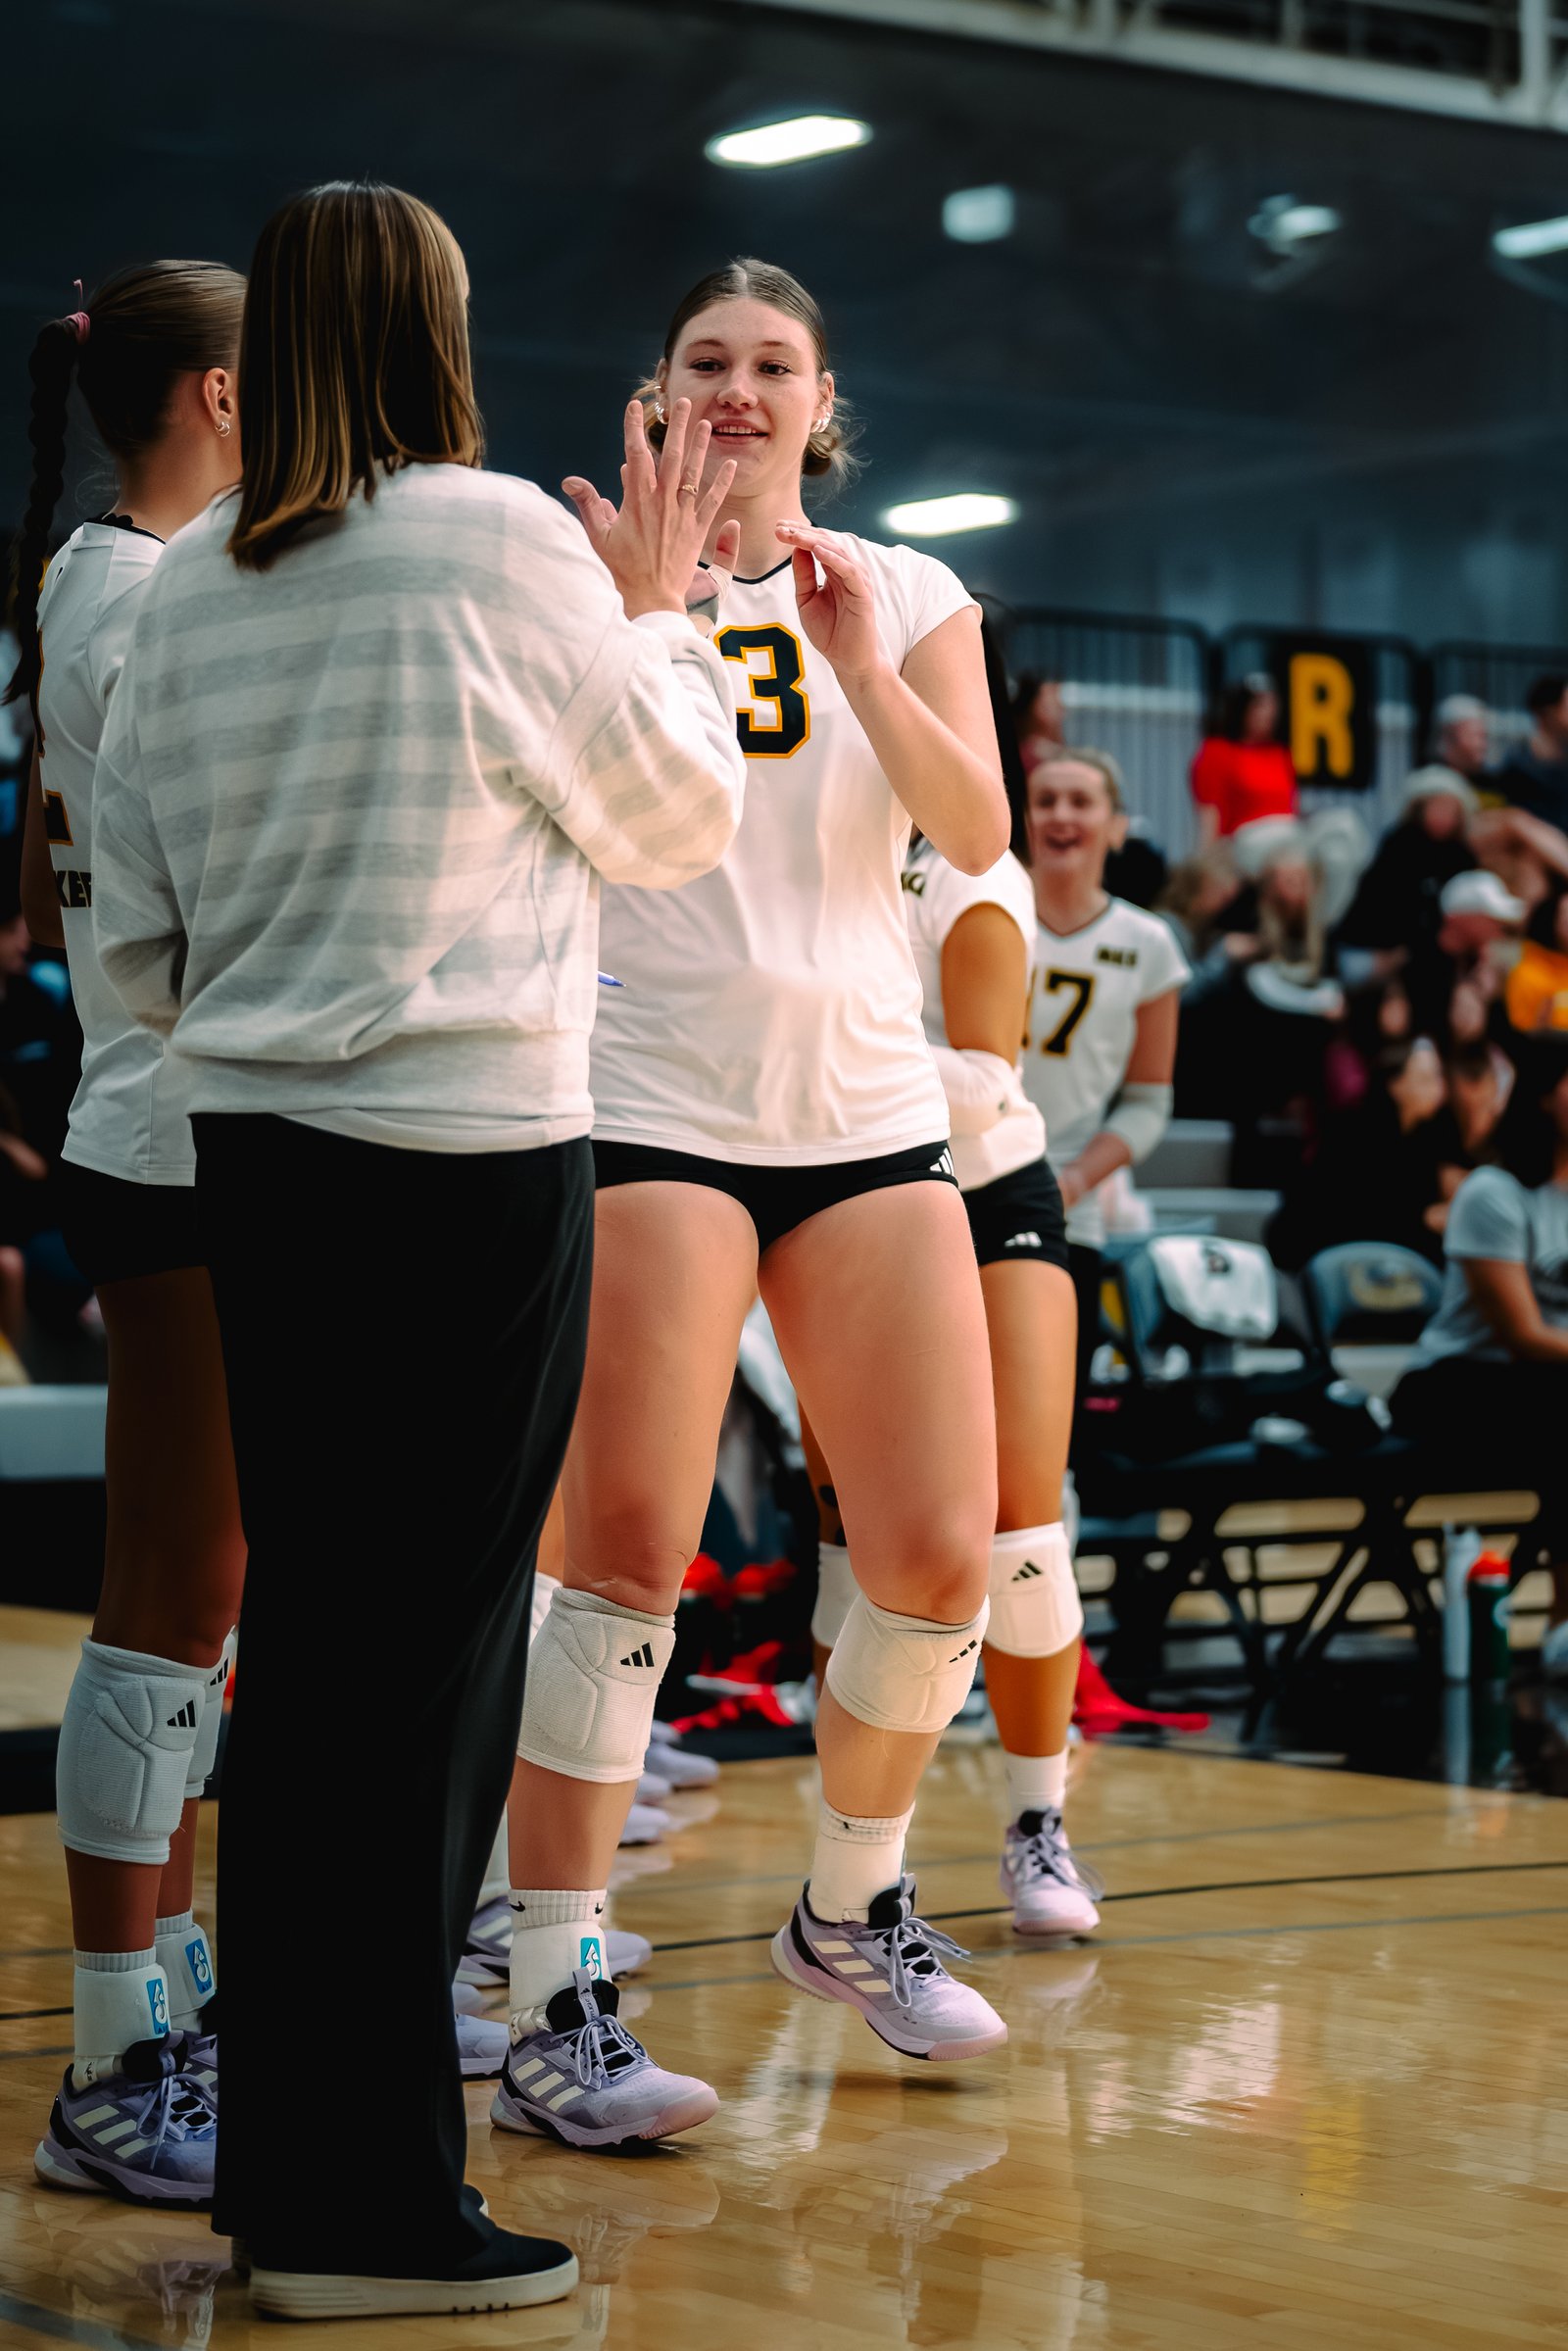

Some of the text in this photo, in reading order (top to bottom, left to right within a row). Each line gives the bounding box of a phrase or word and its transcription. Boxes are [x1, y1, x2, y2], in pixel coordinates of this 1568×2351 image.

[713, 621, 811, 759] 3
[1289, 653, 1355, 779] R
[1021, 965, 1097, 1056] 7
